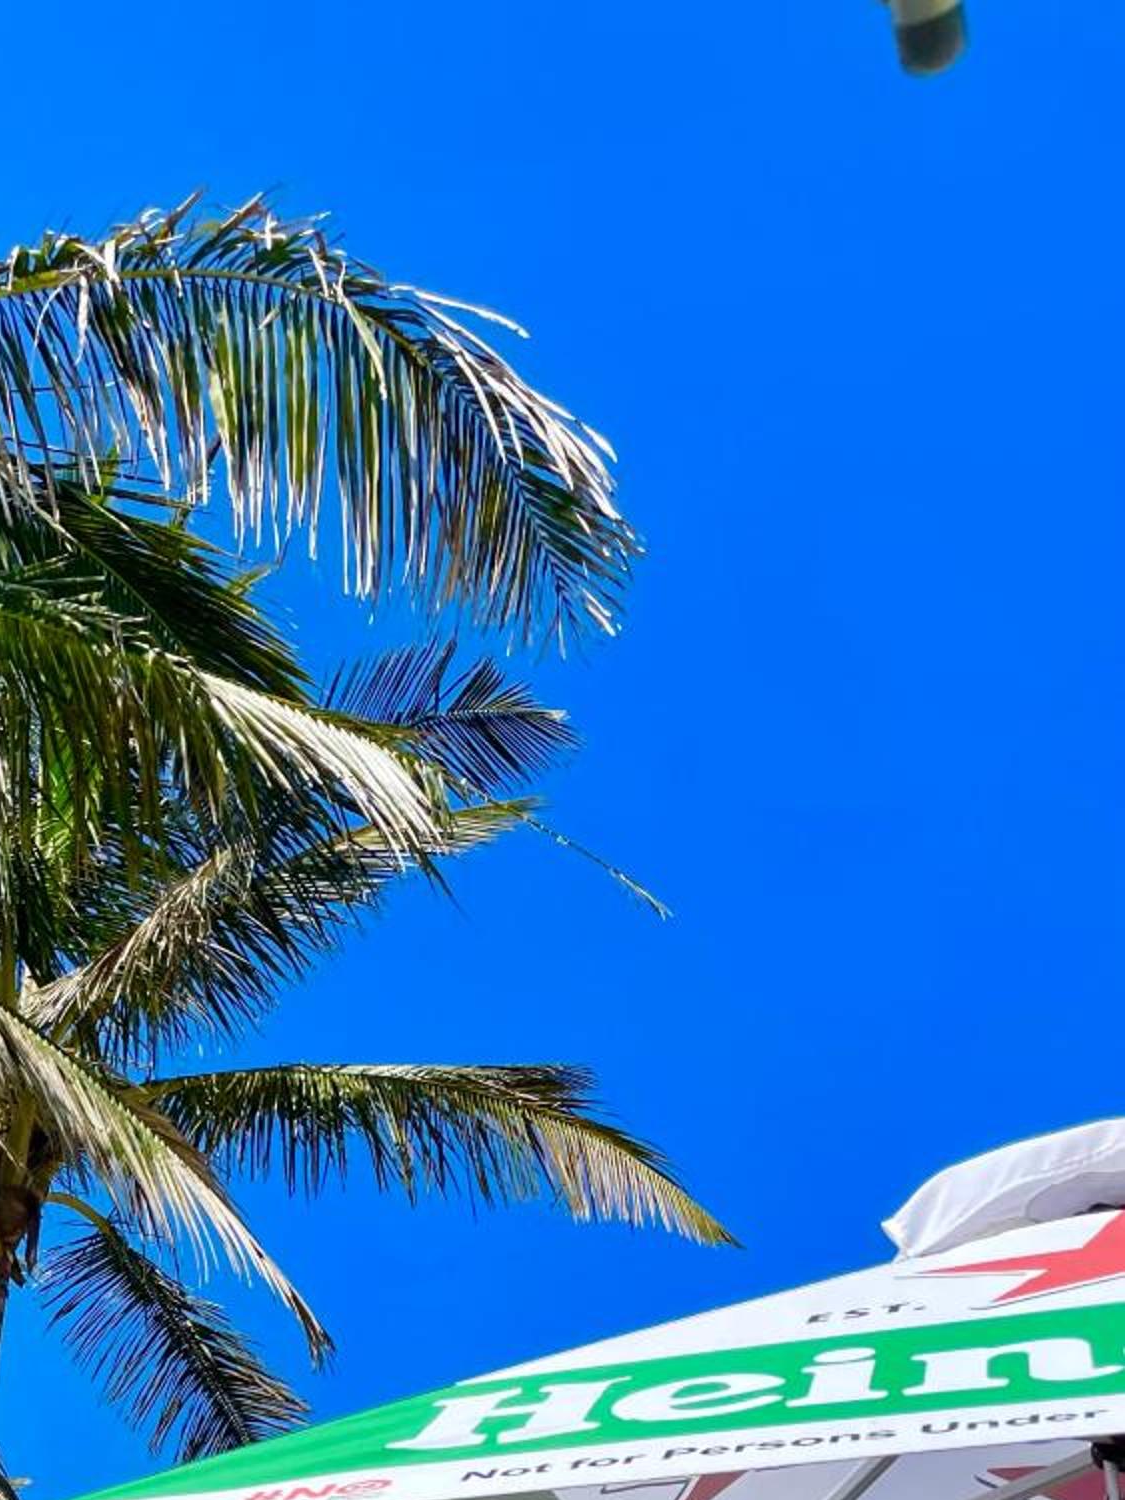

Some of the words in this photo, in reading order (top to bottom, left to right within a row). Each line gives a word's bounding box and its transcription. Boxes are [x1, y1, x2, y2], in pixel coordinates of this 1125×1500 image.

[806, 1301, 927, 1324] EST.
[461, 1463, 552, 1482] Not
[570, 1454, 646, 1470] for
[662, 1430, 897, 1460] Persons
[921, 1409, 1110, 1435] Under
